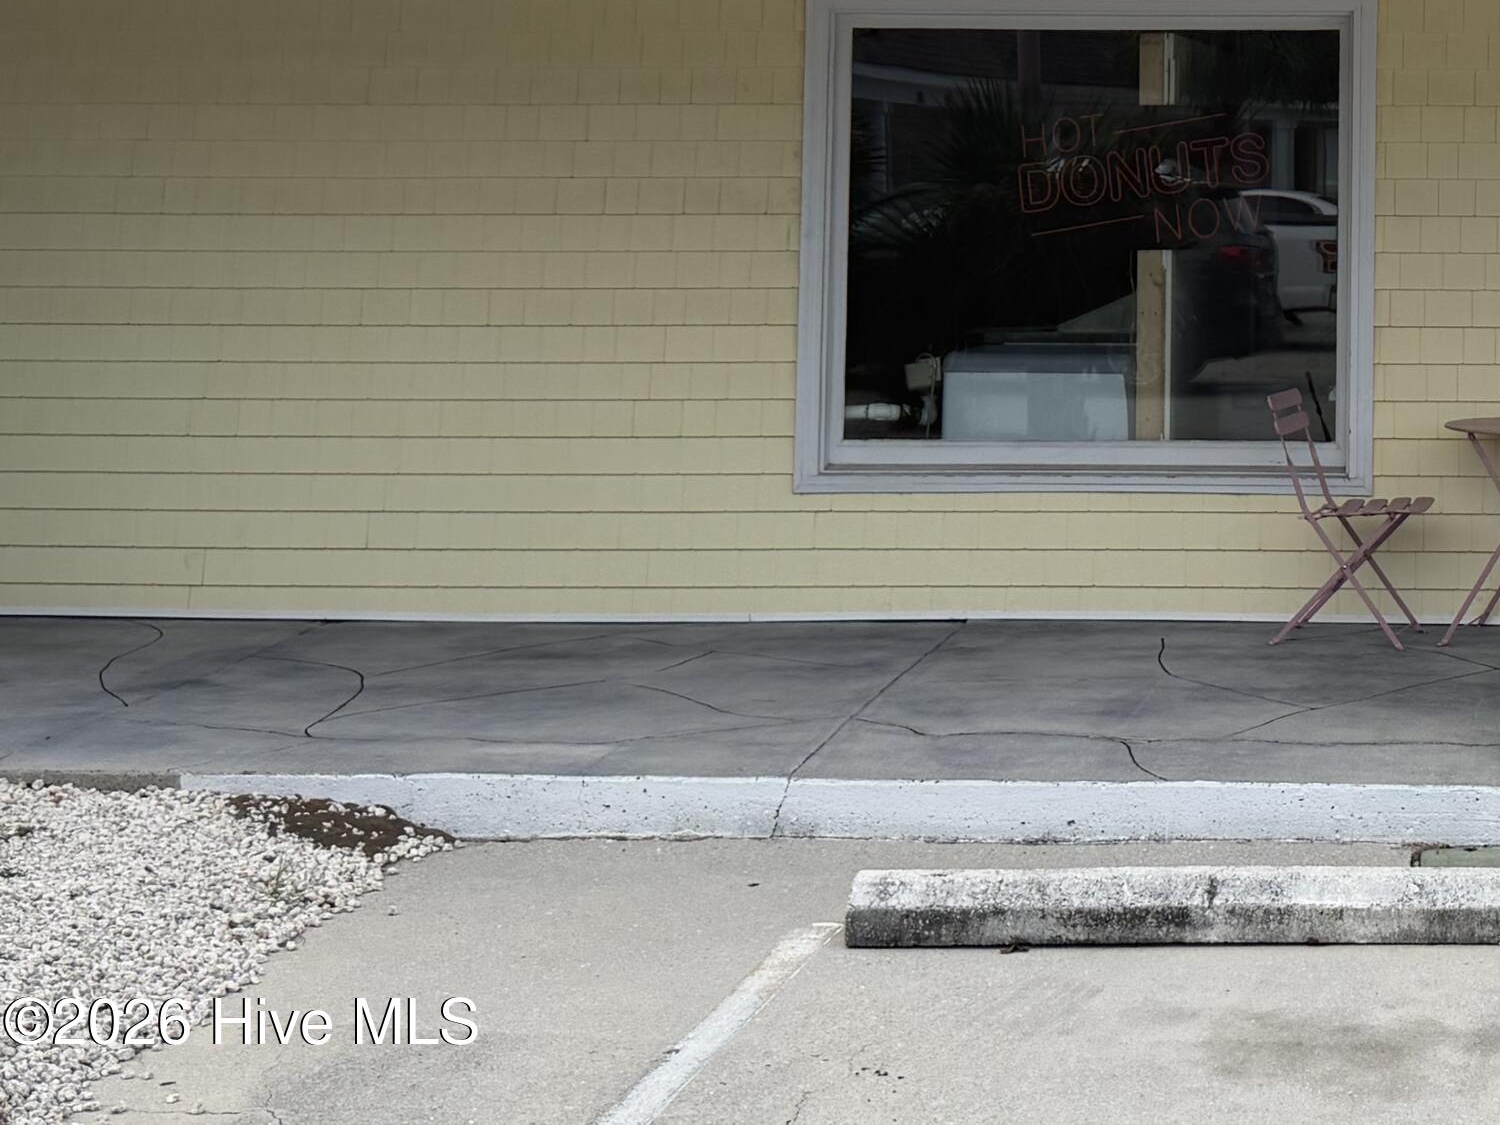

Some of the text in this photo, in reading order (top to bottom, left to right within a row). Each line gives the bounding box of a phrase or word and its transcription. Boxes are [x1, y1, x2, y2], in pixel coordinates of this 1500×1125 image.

[1020, 113, 1104, 158] HOT
[1018, 131, 1270, 214] DONUTS
[1153, 194, 1263, 245] NOW
